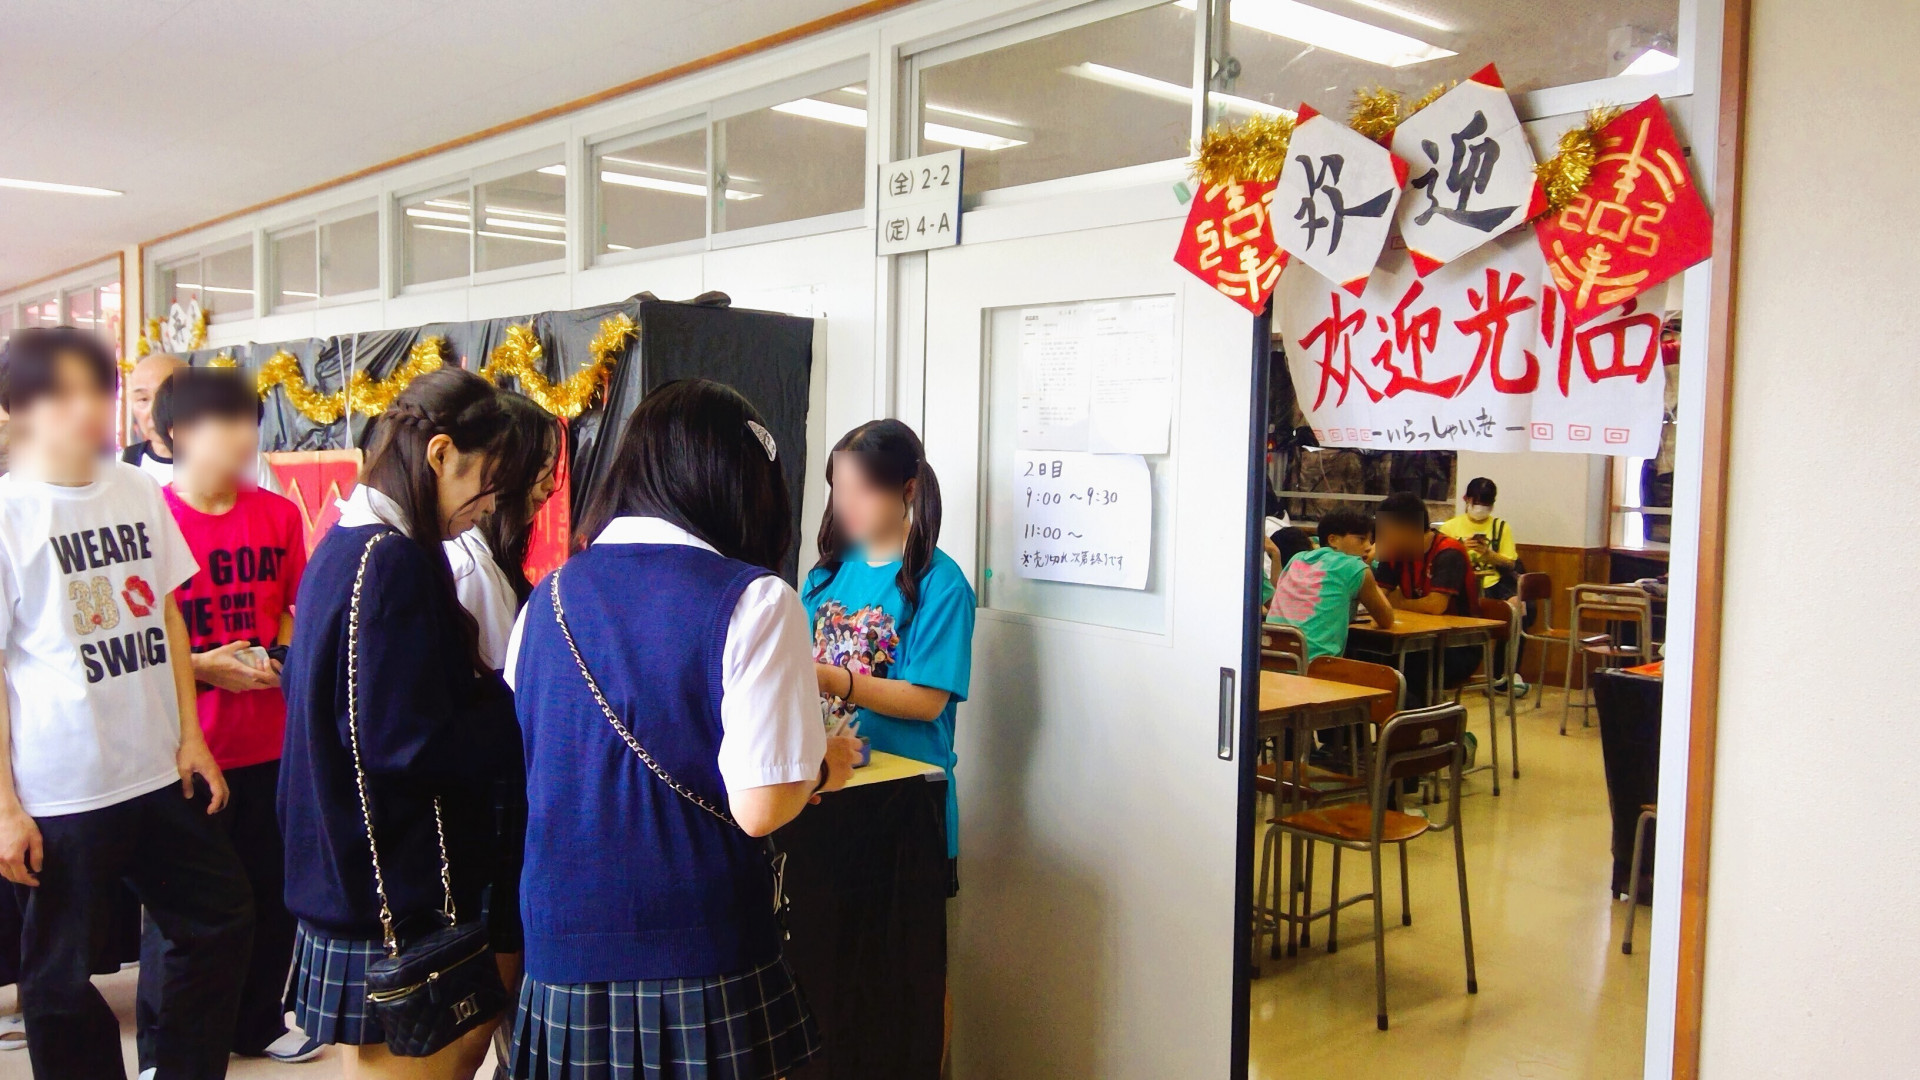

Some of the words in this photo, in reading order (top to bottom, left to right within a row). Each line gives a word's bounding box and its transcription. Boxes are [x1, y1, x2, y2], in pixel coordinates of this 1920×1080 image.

[921, 164, 950, 189] 2-2
[916, 212, 950, 236] 4-A
[68, 576, 121, 635] 38
